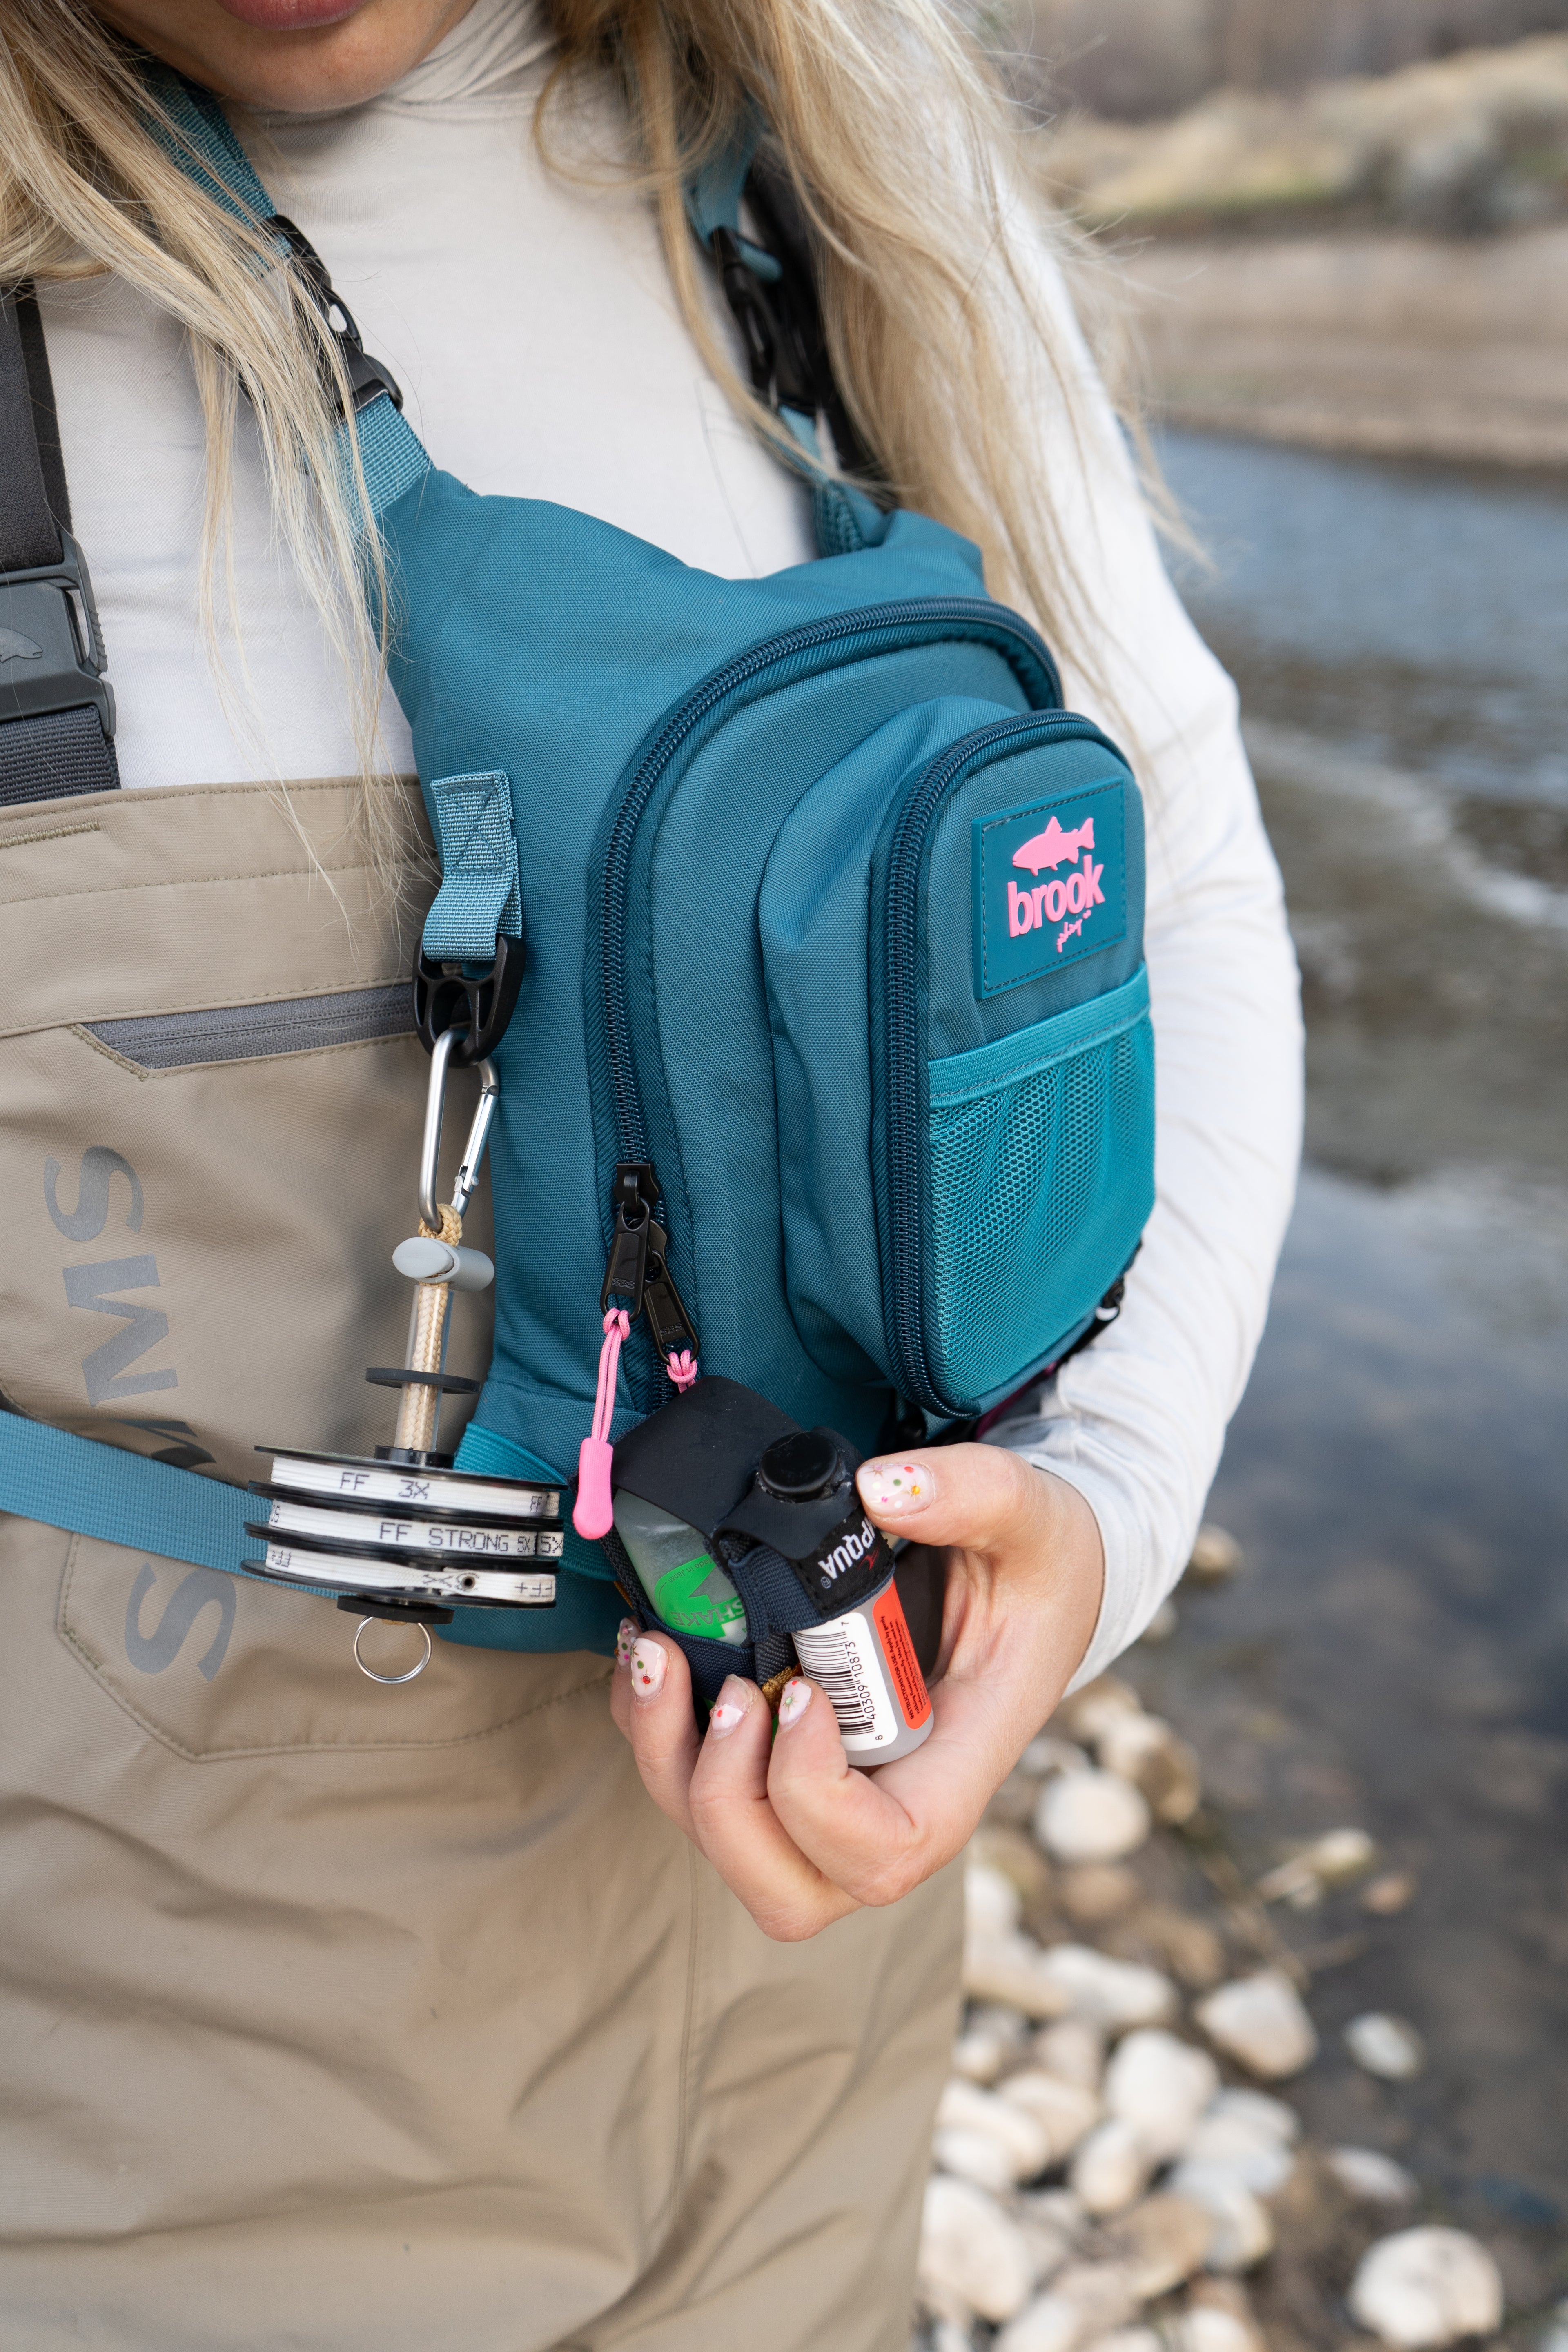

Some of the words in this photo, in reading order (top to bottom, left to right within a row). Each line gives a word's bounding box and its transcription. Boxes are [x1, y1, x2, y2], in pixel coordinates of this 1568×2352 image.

[1007, 854, 1105, 938] brook
[612, 1278, 635, 1289] SBS
[659, 1322, 683, 1336] SBS
[44, 1145, 237, 1682] SMS
[340, 1472, 370, 1490] FF
[398, 1479, 430, 1500] 3X
[530, 1496, 542, 1512] FF
[379, 1522, 412, 1541] FF
[428, 1528, 509, 1552] STRONG
[517, 1536, 531, 1553] 5X
[817, 1516, 875, 1580] PQUA
[668, 1570, 686, 1583] Japan
[670, 1598, 744, 1626] SHAKE
[880, 1616, 889, 1631] gently
[845, 1642, 864, 1677] 10873
[857, 1685, 877, 1720] 40309
[898, 1677, 914, 1720] INSTRUCTIONS
